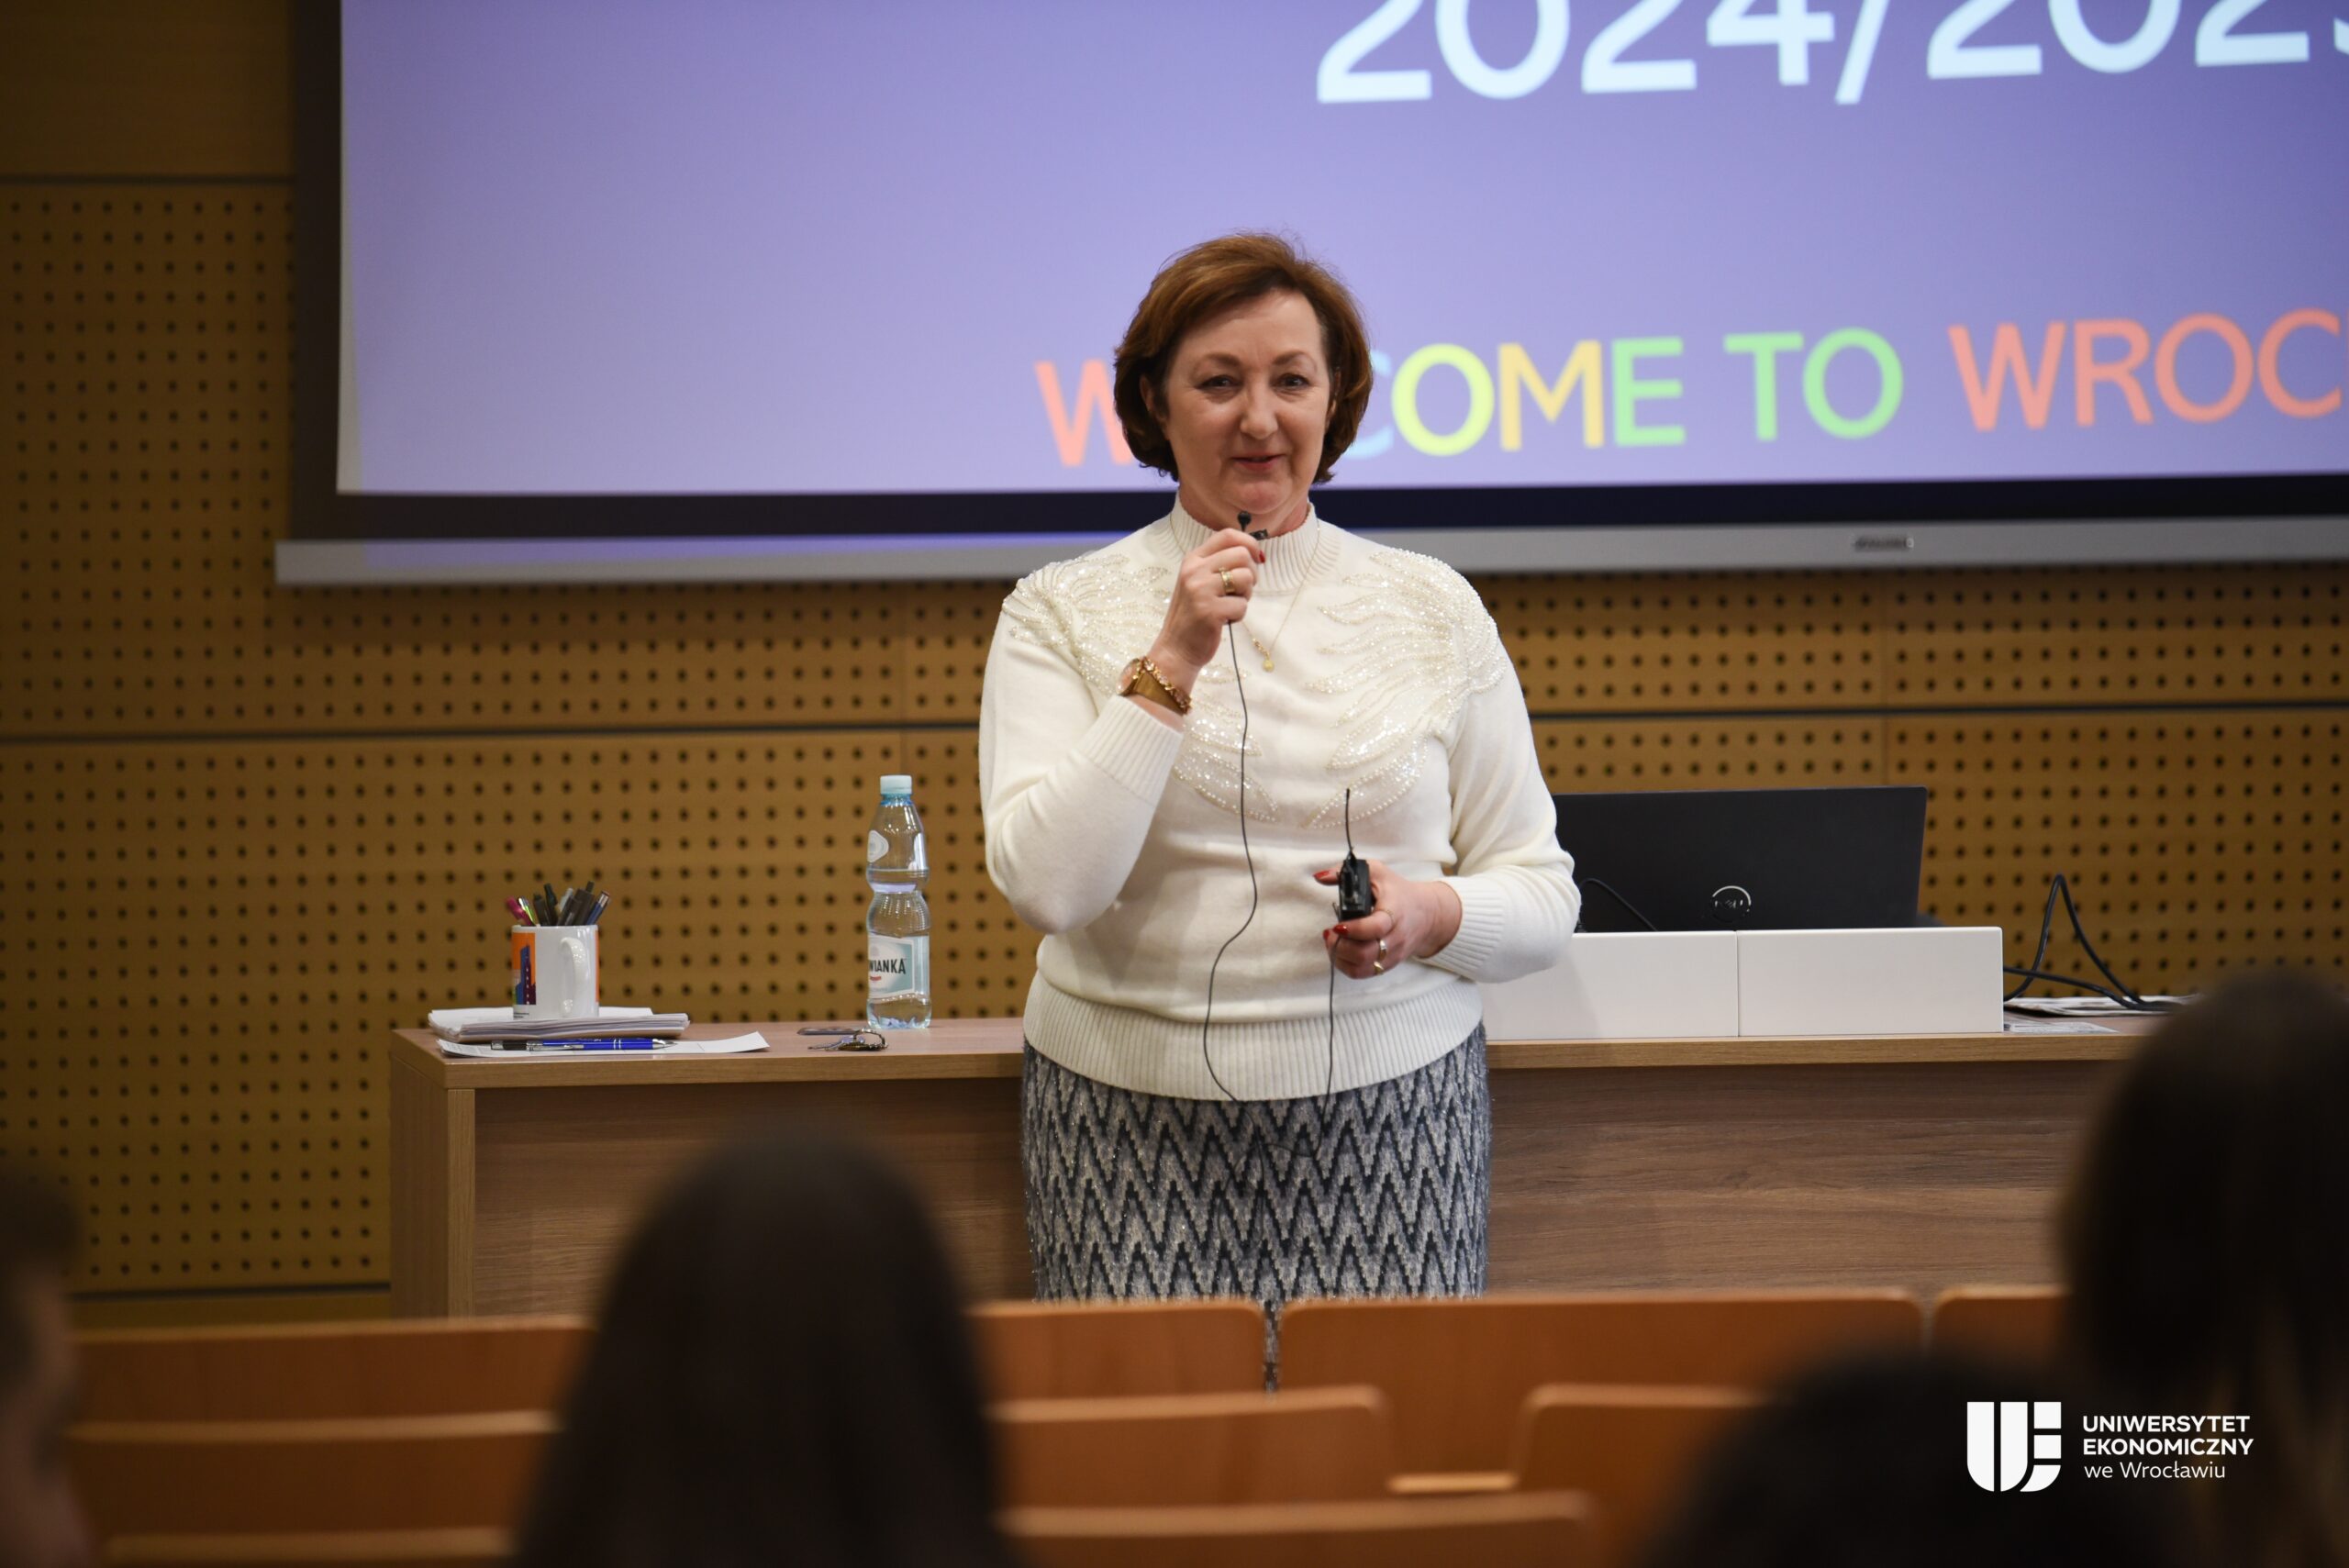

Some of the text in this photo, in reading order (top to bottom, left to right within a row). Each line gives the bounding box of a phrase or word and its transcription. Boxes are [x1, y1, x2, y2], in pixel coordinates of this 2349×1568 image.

[1033, 306, 2349, 468] WOME TO WROC
